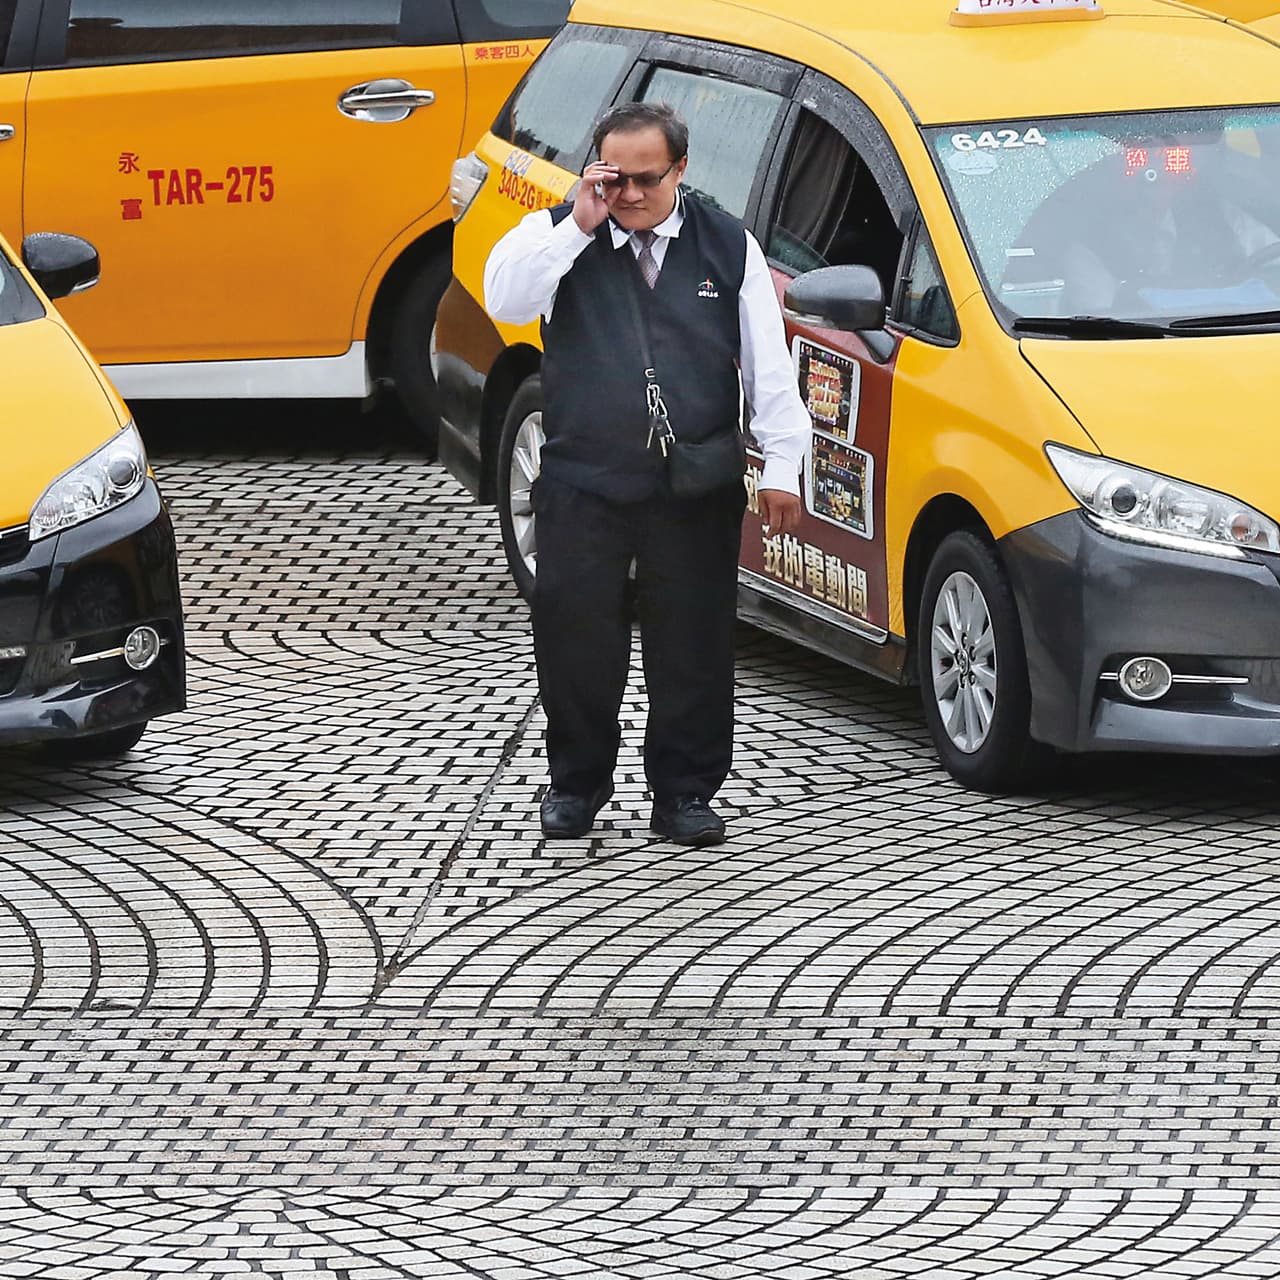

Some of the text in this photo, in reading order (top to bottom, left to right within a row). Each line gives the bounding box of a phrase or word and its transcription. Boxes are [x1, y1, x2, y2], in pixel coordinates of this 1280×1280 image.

[474, 44, 535, 60] 乘客四人
[950, 126, 1048, 152] 6424
[148, 165, 275, 206] TAR-275
[498, 169, 536, 210] 340-2G
